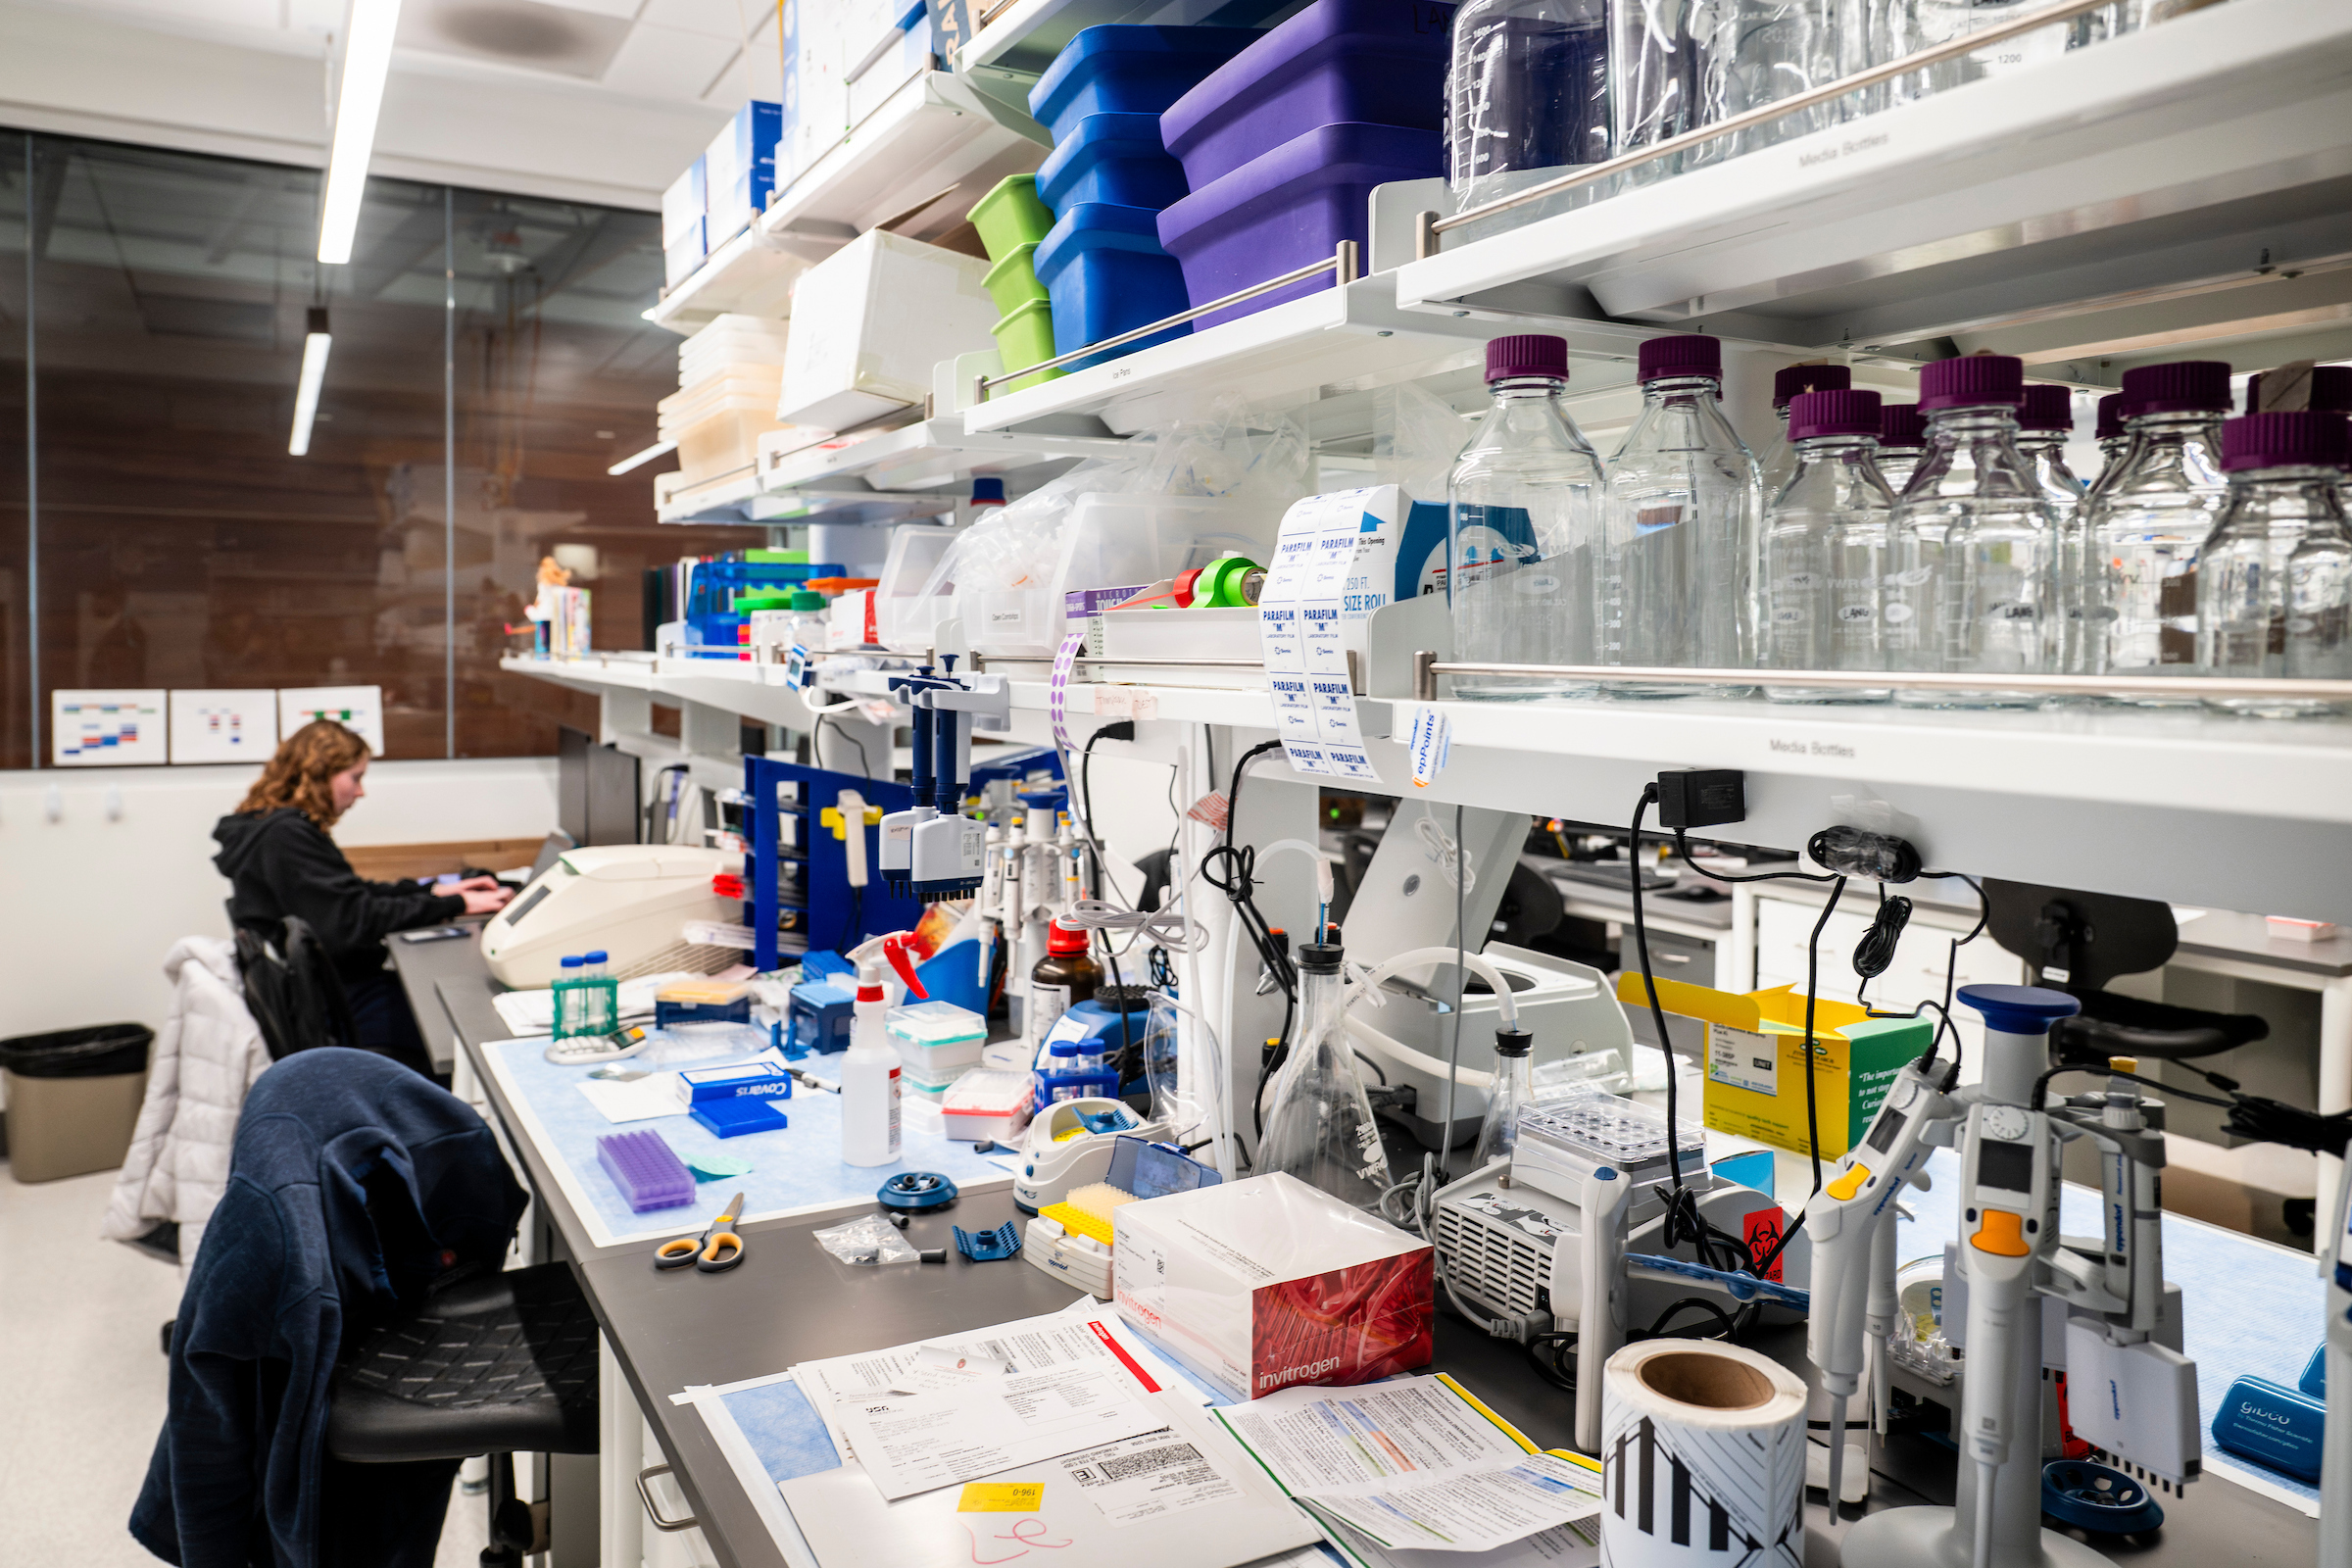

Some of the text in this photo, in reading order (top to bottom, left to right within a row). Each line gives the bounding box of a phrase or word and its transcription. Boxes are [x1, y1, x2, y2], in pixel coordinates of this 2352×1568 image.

[1412, 4, 1451, 33] LAN
[1998, 54, 2022, 64] 1200
[1799, 134, 1888, 168] Media Bottles
[1320, 537, 1354, 550] PARAFILM
[1367, 536, 1385, 546] Opening
[1281, 542, 1312, 554] PARAFILM
[1344, 595, 1362, 612] SIZE
[1263, 611, 1295, 621] PARAFILM
[1303, 610, 1338, 620] PARAFILM
[1843, 609, 1869, 620] LANG
[1272, 681, 1305, 692] PARAFILM
[1313, 683, 1348, 695] PARAFILM
[1289, 748, 1323, 760] PARAFILM
[1770, 739, 1855, 759] Media Bottles
[1330, 752, 1367, 765] PARAFILM
[736, 1082, 787, 1098] Covaris
[1866, 1086, 1878, 1096] not
[1356, 1161, 1383, 1180] VWR
[1116, 1284, 1162, 1330] invitrogen
[1259, 1354, 1341, 1390] invitrogen
[2240, 1400, 2290, 1425] gibco
[1012, 1488, 1036, 1496] 196-0
